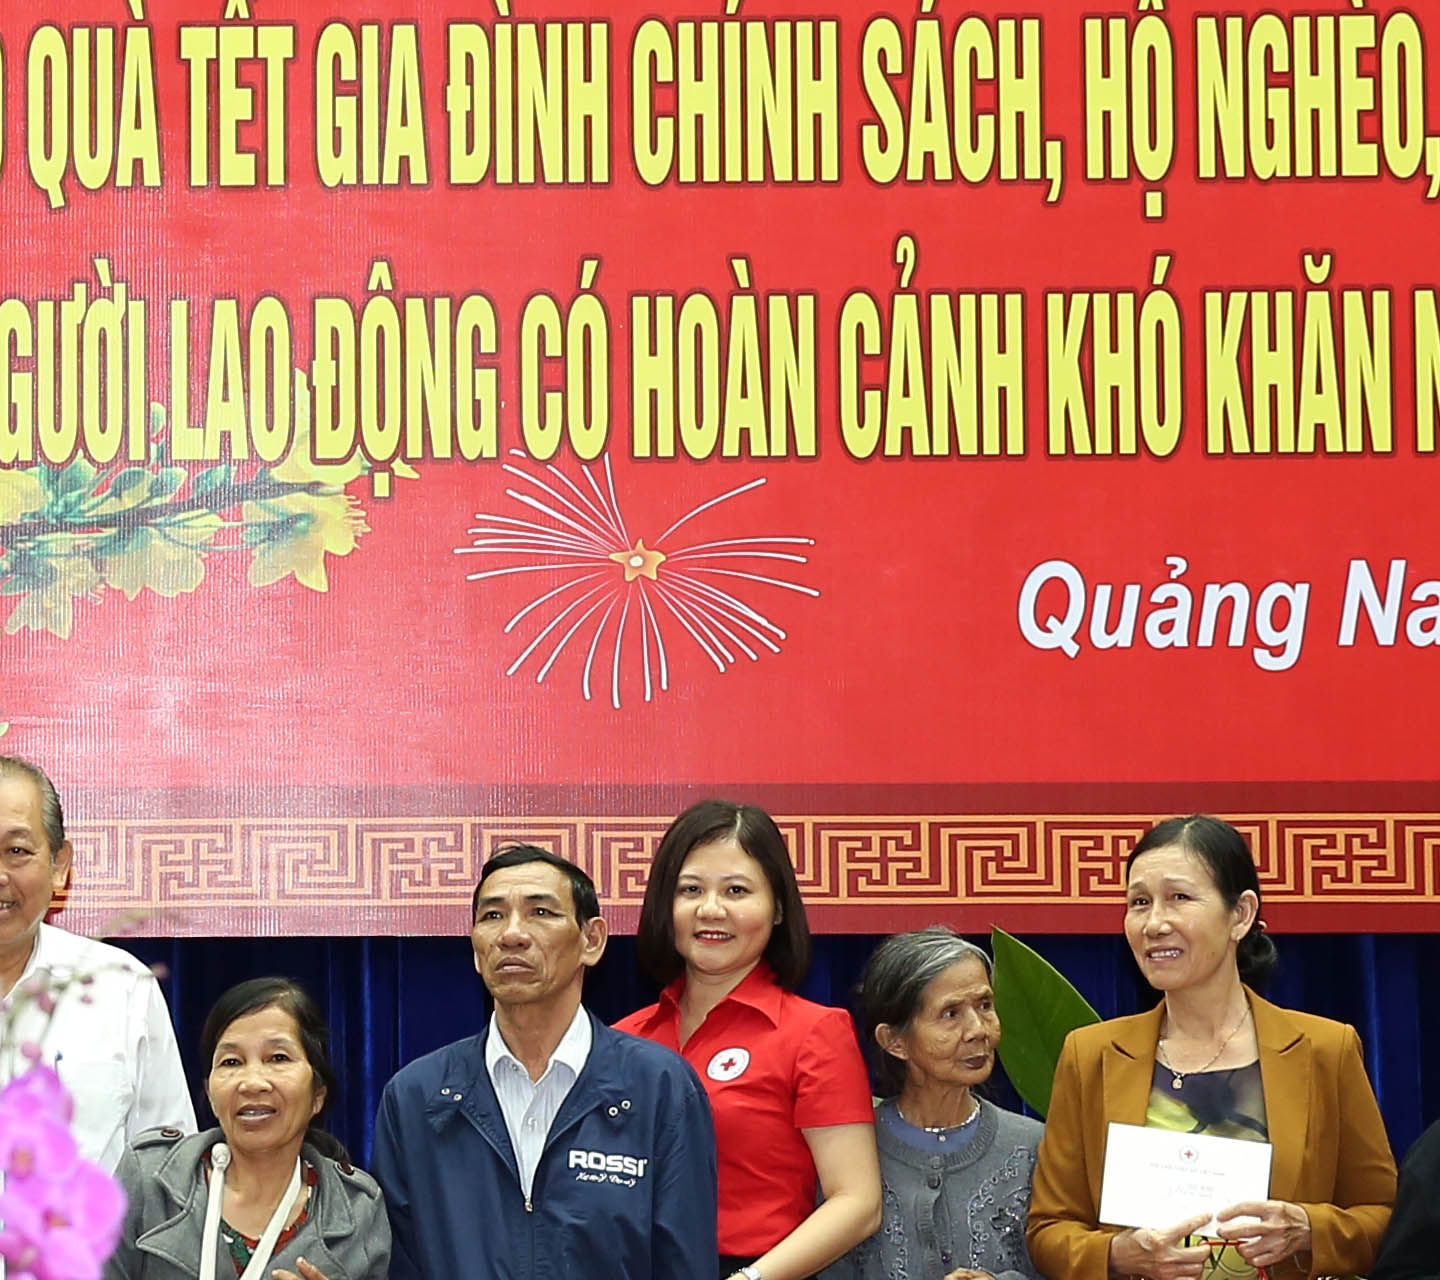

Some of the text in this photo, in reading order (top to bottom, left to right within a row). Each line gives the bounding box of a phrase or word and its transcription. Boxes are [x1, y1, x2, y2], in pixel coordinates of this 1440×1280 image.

[316, 23, 428, 187] GIA
[171, 295, 292, 463] LAO
[312, 261, 497, 498] ĐỘNG
[521, 260, 608, 460] CÓ
[632, 259, 816, 459] HOÀN
[839, 236, 1024, 458] CẢNH
[1047, 255, 1182, 457] KHÓ
[1205, 254, 1392, 454] KHĂN
[1017, 556, 1310, 671] Quảng
[569, 1150, 645, 1177] ROSSI
